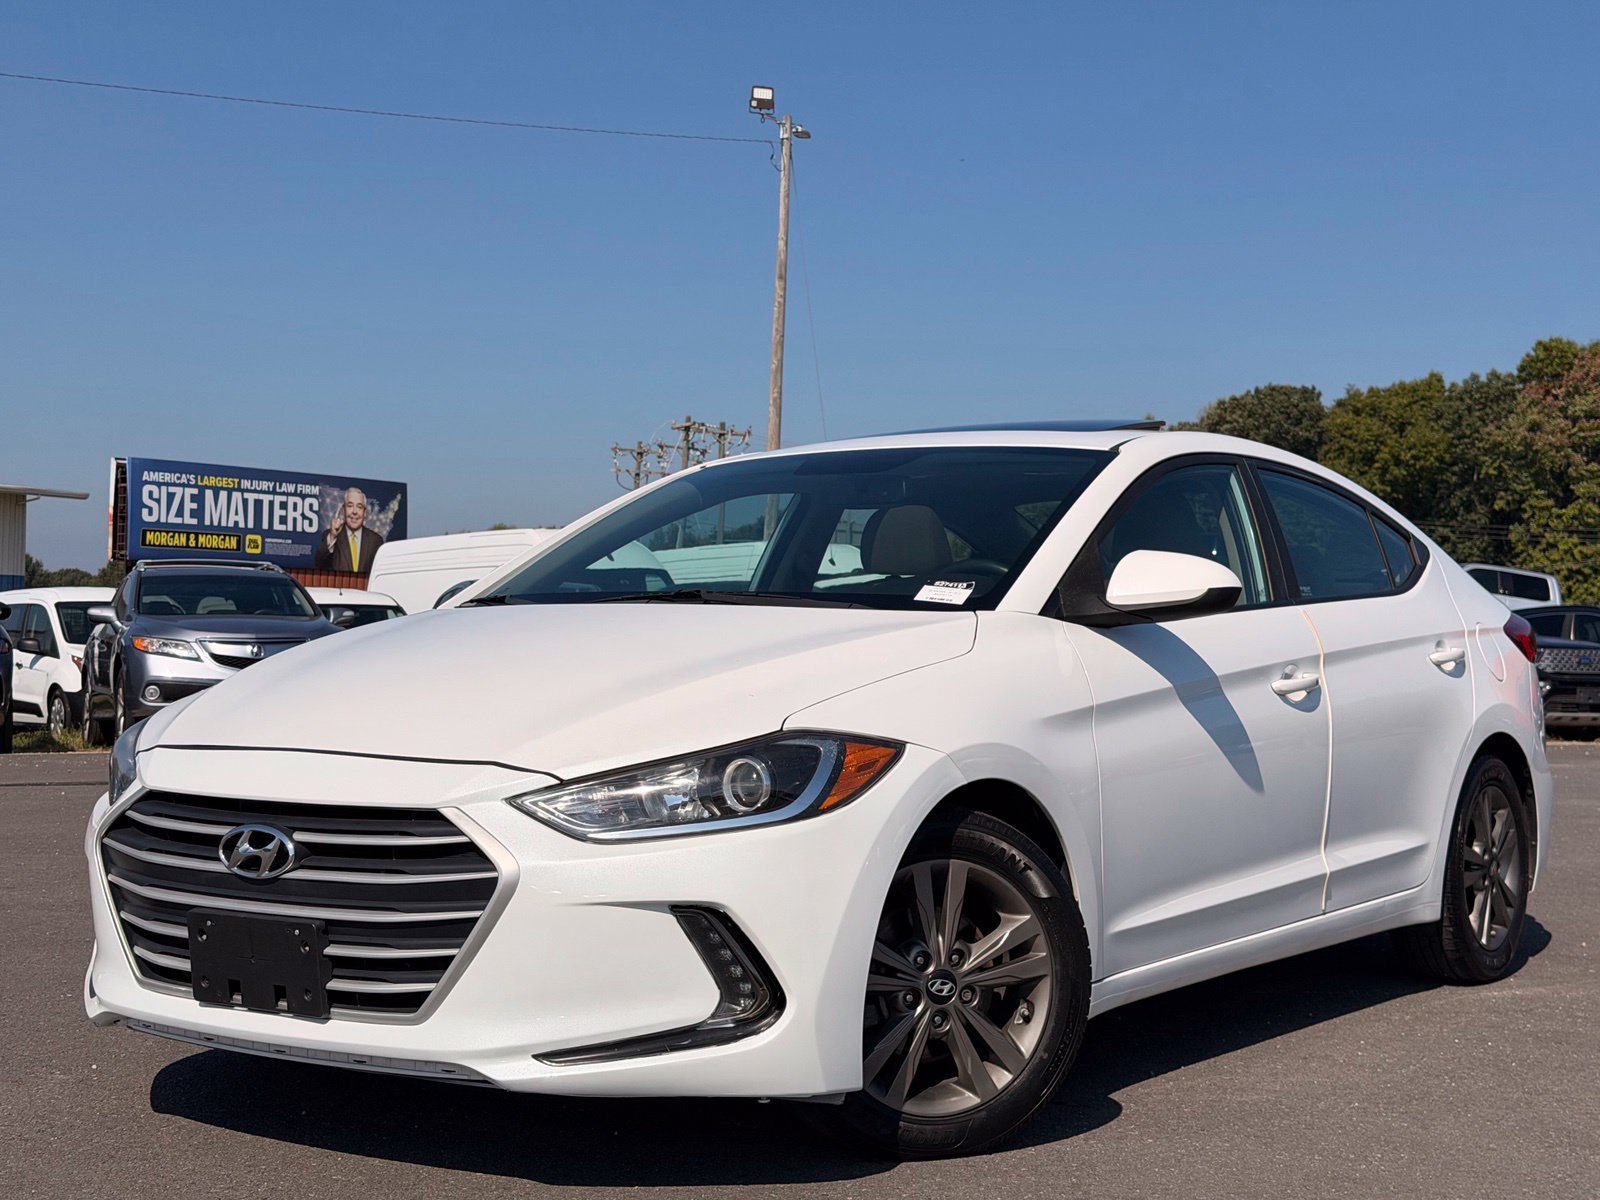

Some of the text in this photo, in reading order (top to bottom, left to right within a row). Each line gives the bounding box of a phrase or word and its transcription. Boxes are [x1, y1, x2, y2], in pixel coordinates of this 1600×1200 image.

[142, 471, 320, 495] AMERICA'S LARGEST INJURY LAW FIRM
[141, 484, 319, 533] SIZE MATTERS
[145, 531, 187, 547] MORGAN
[188, 533, 196, 547] &
[198, 534, 237, 550] MORGAN
